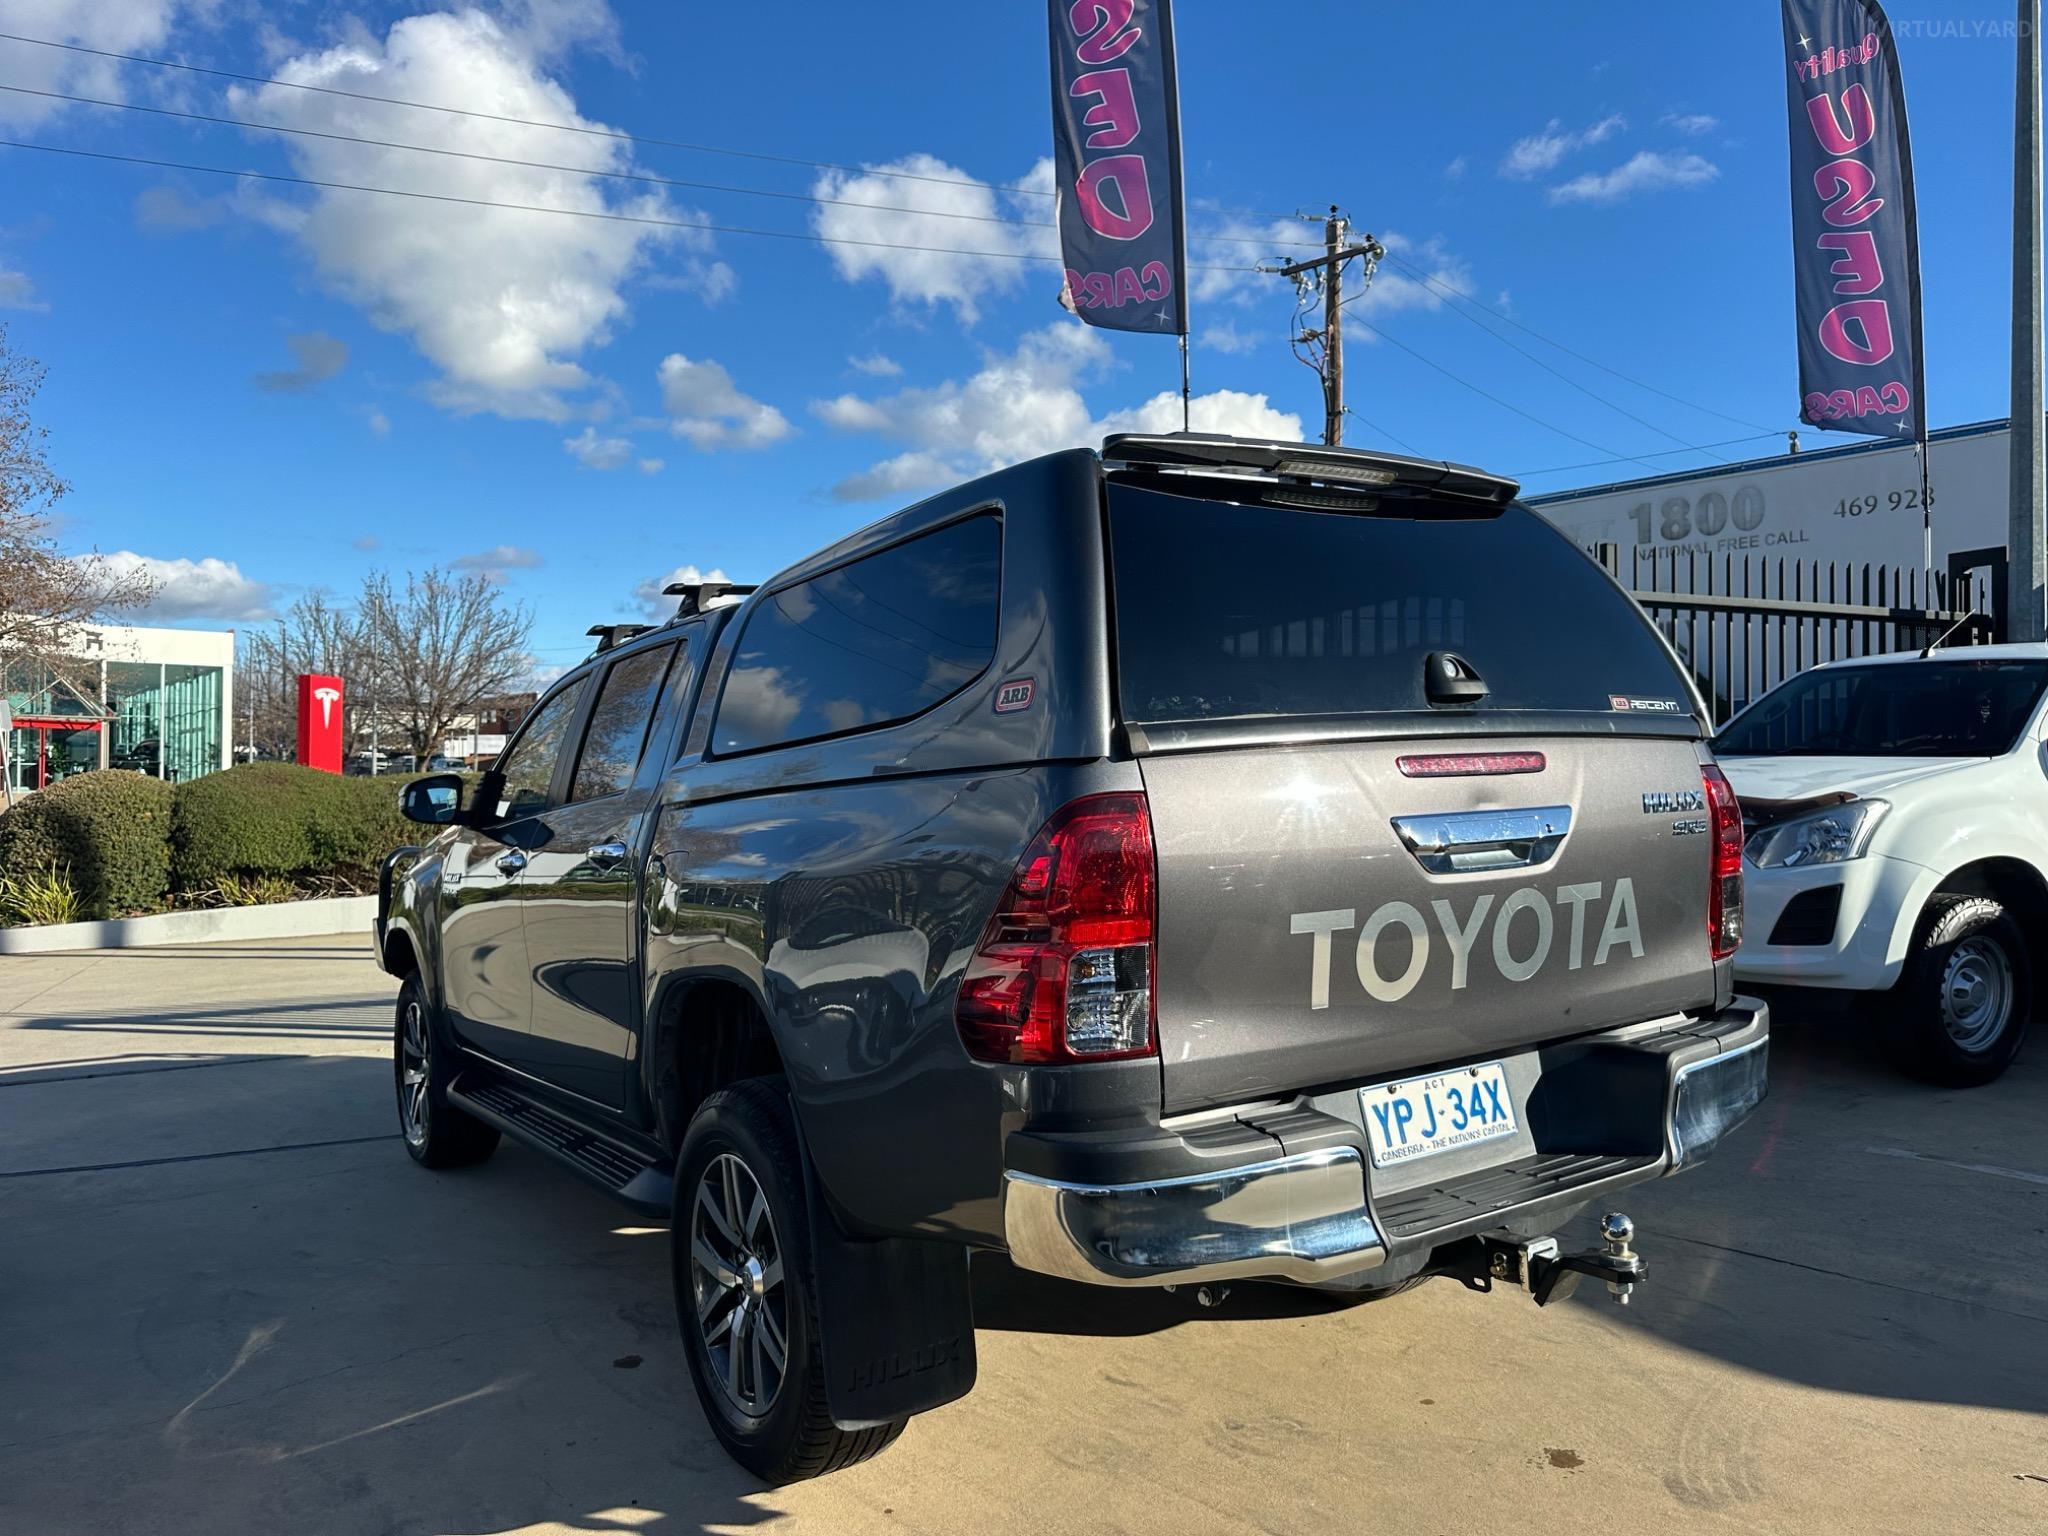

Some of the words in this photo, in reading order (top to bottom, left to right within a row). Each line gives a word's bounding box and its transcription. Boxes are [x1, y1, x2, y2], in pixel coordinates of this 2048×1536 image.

[1628, 485, 1766, 545] 1800
[1833, 494, 1878, 518] 469
[1888, 487, 1935, 512] 928
[1637, 541, 1713, 561] NATIONAL
[1717, 534, 1761, 553] FREE
[1764, 528, 1811, 547] CALL
[1000, 686, 1031, 705] ARB
[1642, 790, 1704, 814] HILUX
[1290, 877, 1645, 1010] TOYOTA
[1424, 1077, 1446, 1091] ACT
[1381, 1143, 1425, 1162] CANBERRA
[1431, 1136, 1448, 1149] THE
[1482, 1121, 1512, 1137] CAPITAL
[848, 1337, 960, 1393] HILUX
